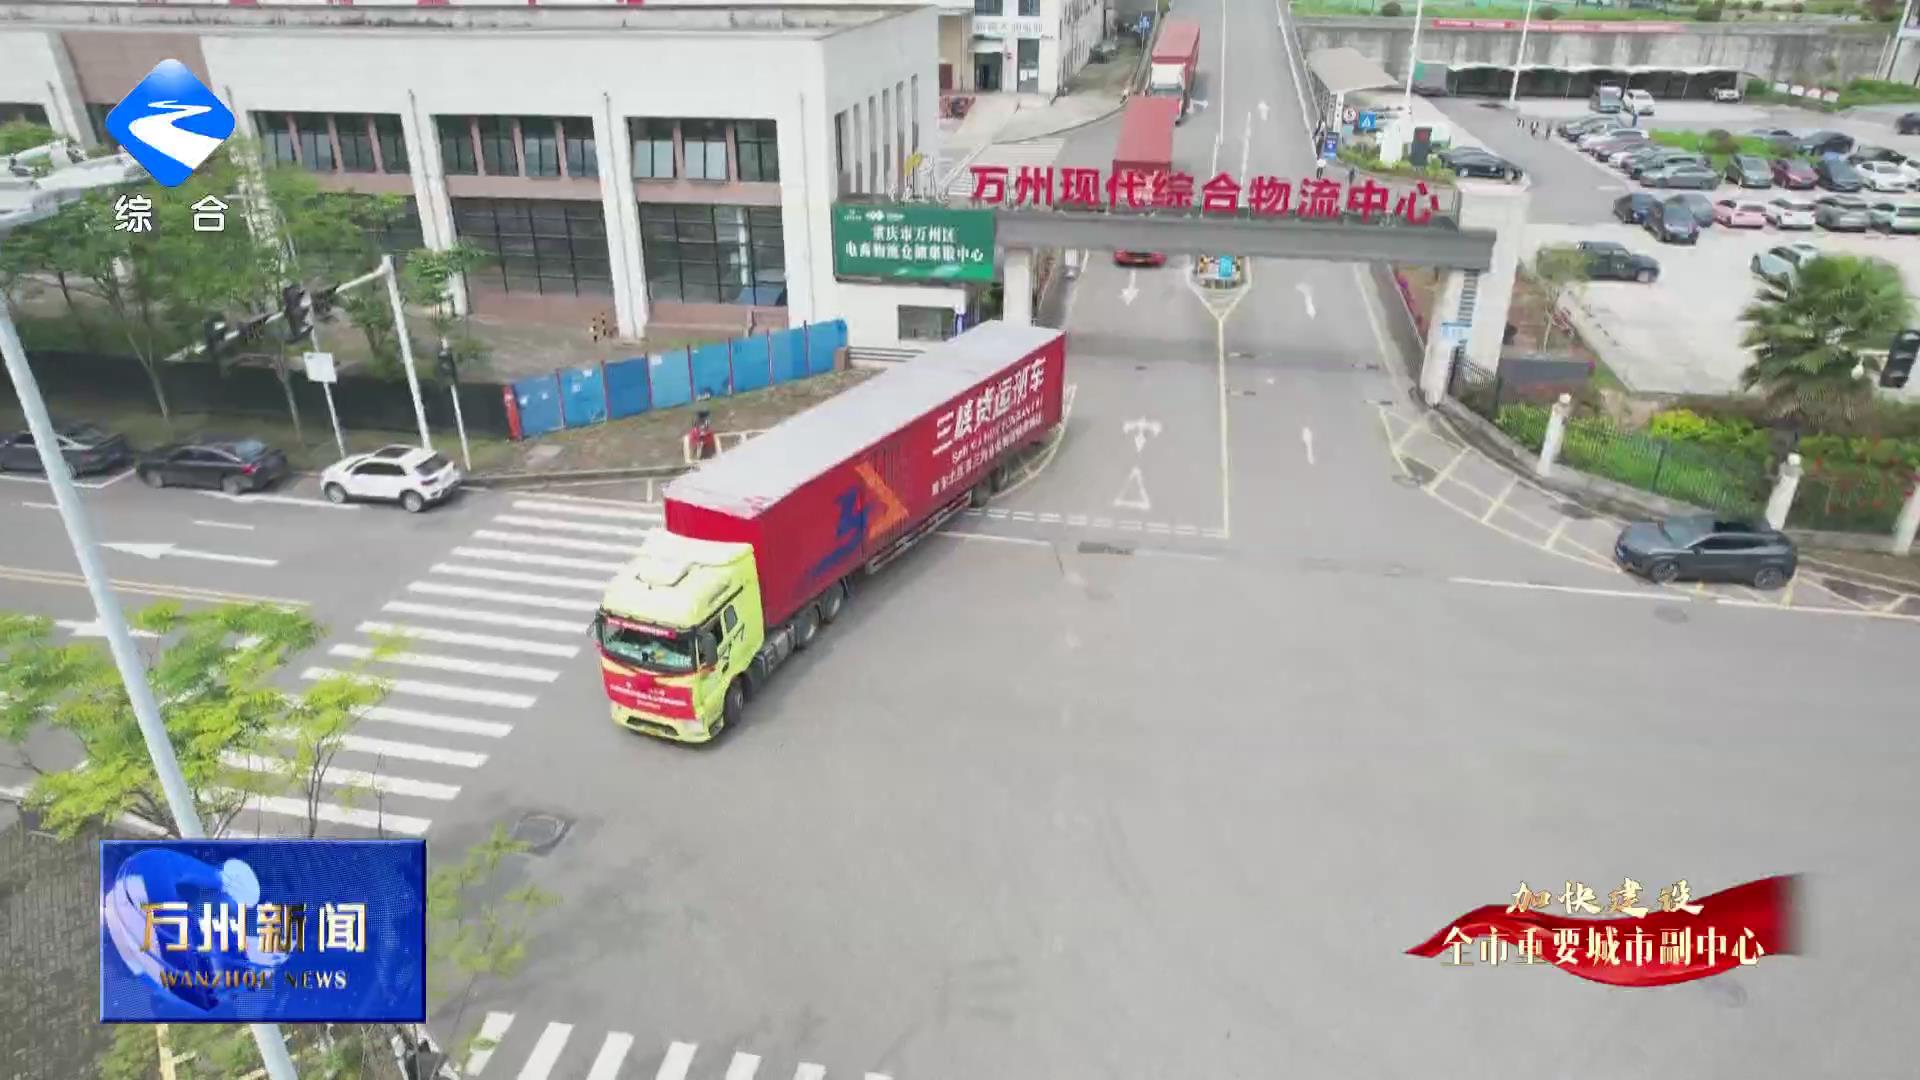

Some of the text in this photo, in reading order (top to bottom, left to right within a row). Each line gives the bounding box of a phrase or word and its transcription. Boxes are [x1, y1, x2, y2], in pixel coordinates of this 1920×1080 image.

[970, 164, 1440, 227] 万州现代综合物流中心
[872, 224, 957, 243] 重庆市万州区
